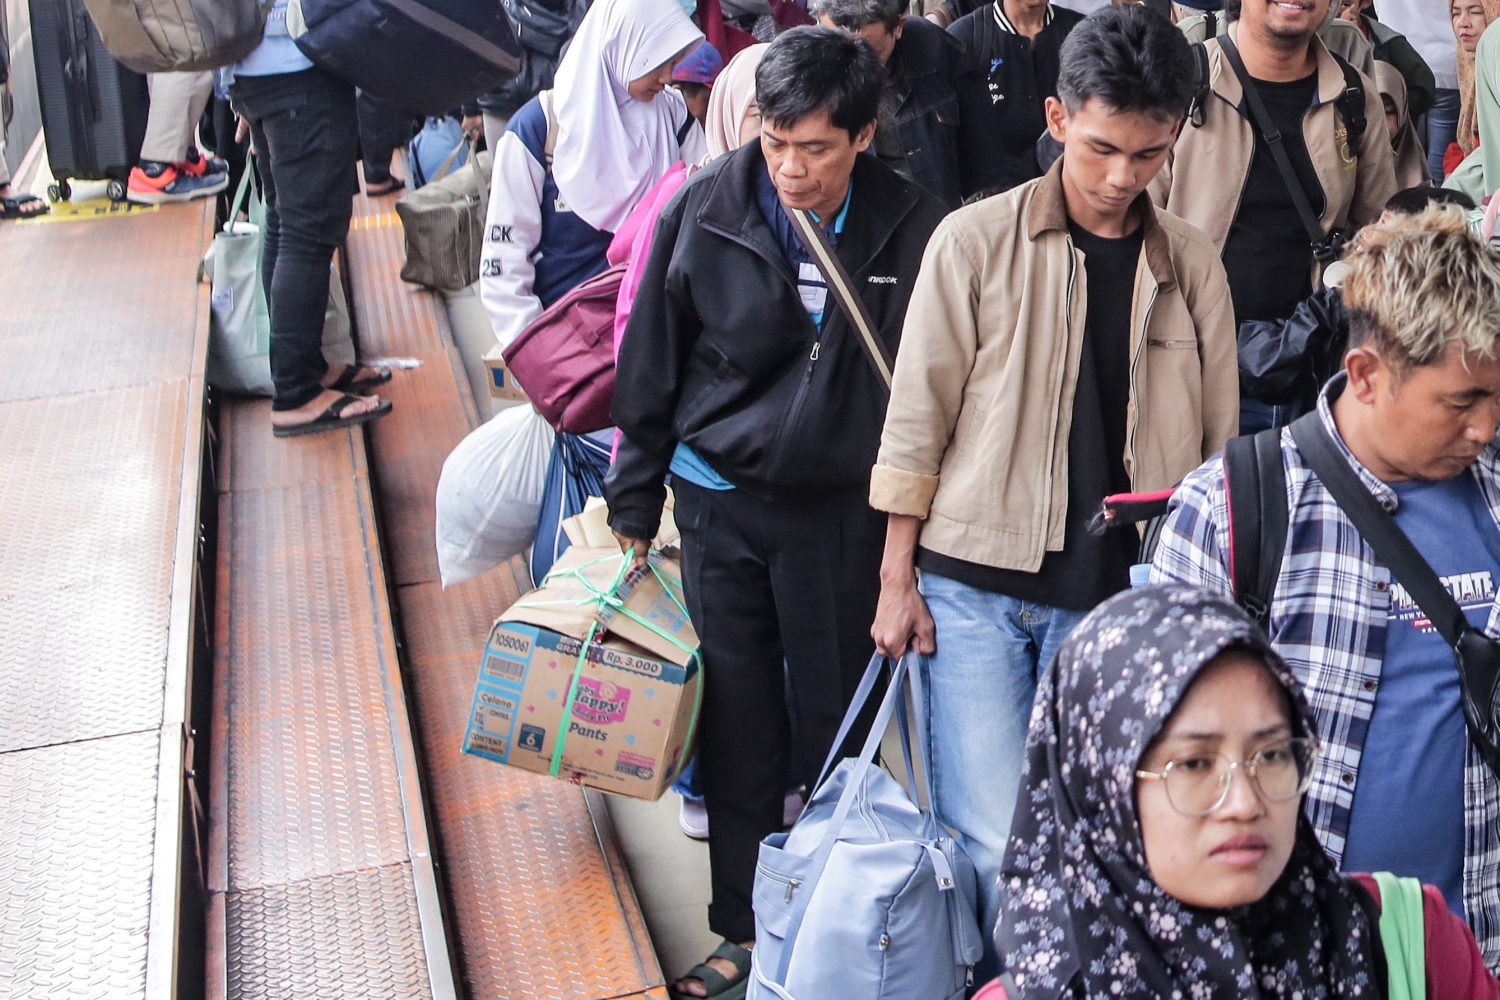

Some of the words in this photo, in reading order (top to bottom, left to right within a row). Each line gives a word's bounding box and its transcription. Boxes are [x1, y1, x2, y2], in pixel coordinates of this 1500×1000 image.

[607, 651, 623, 664] Rp.
[625, 657, 659, 673] 3.000
[526, 732, 536, 746] 6
[568, 721, 608, 741] Pants
